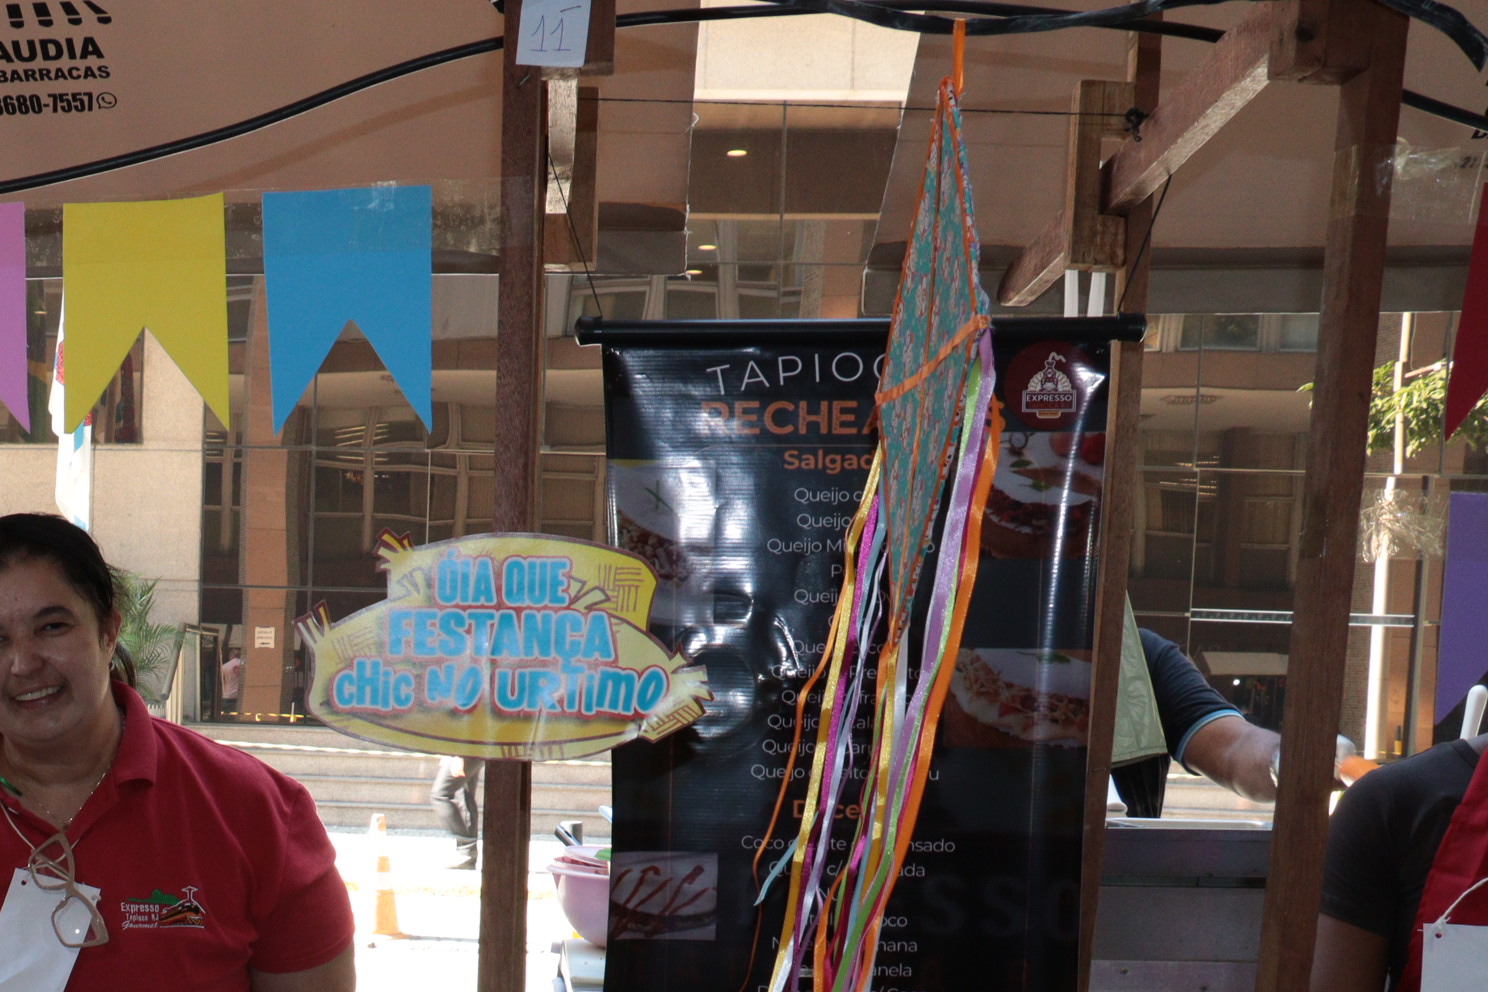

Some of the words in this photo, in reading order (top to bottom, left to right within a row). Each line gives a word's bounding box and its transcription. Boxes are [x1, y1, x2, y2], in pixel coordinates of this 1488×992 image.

[706, 352, 885, 395] TAPIO
[1026, 394, 1072, 402] EXPRESSO
[794, 487, 849, 505] Queijo
[796, 513, 852, 531] Queijo
[767, 538, 822, 555] Queijo
[502, 556, 570, 606] QUE
[794, 589, 840, 606] Queij
[386, 610, 616, 666] FESTANÇA
[751, 764, 805, 780] Quejo
[120, 902, 160, 914] Expresso
